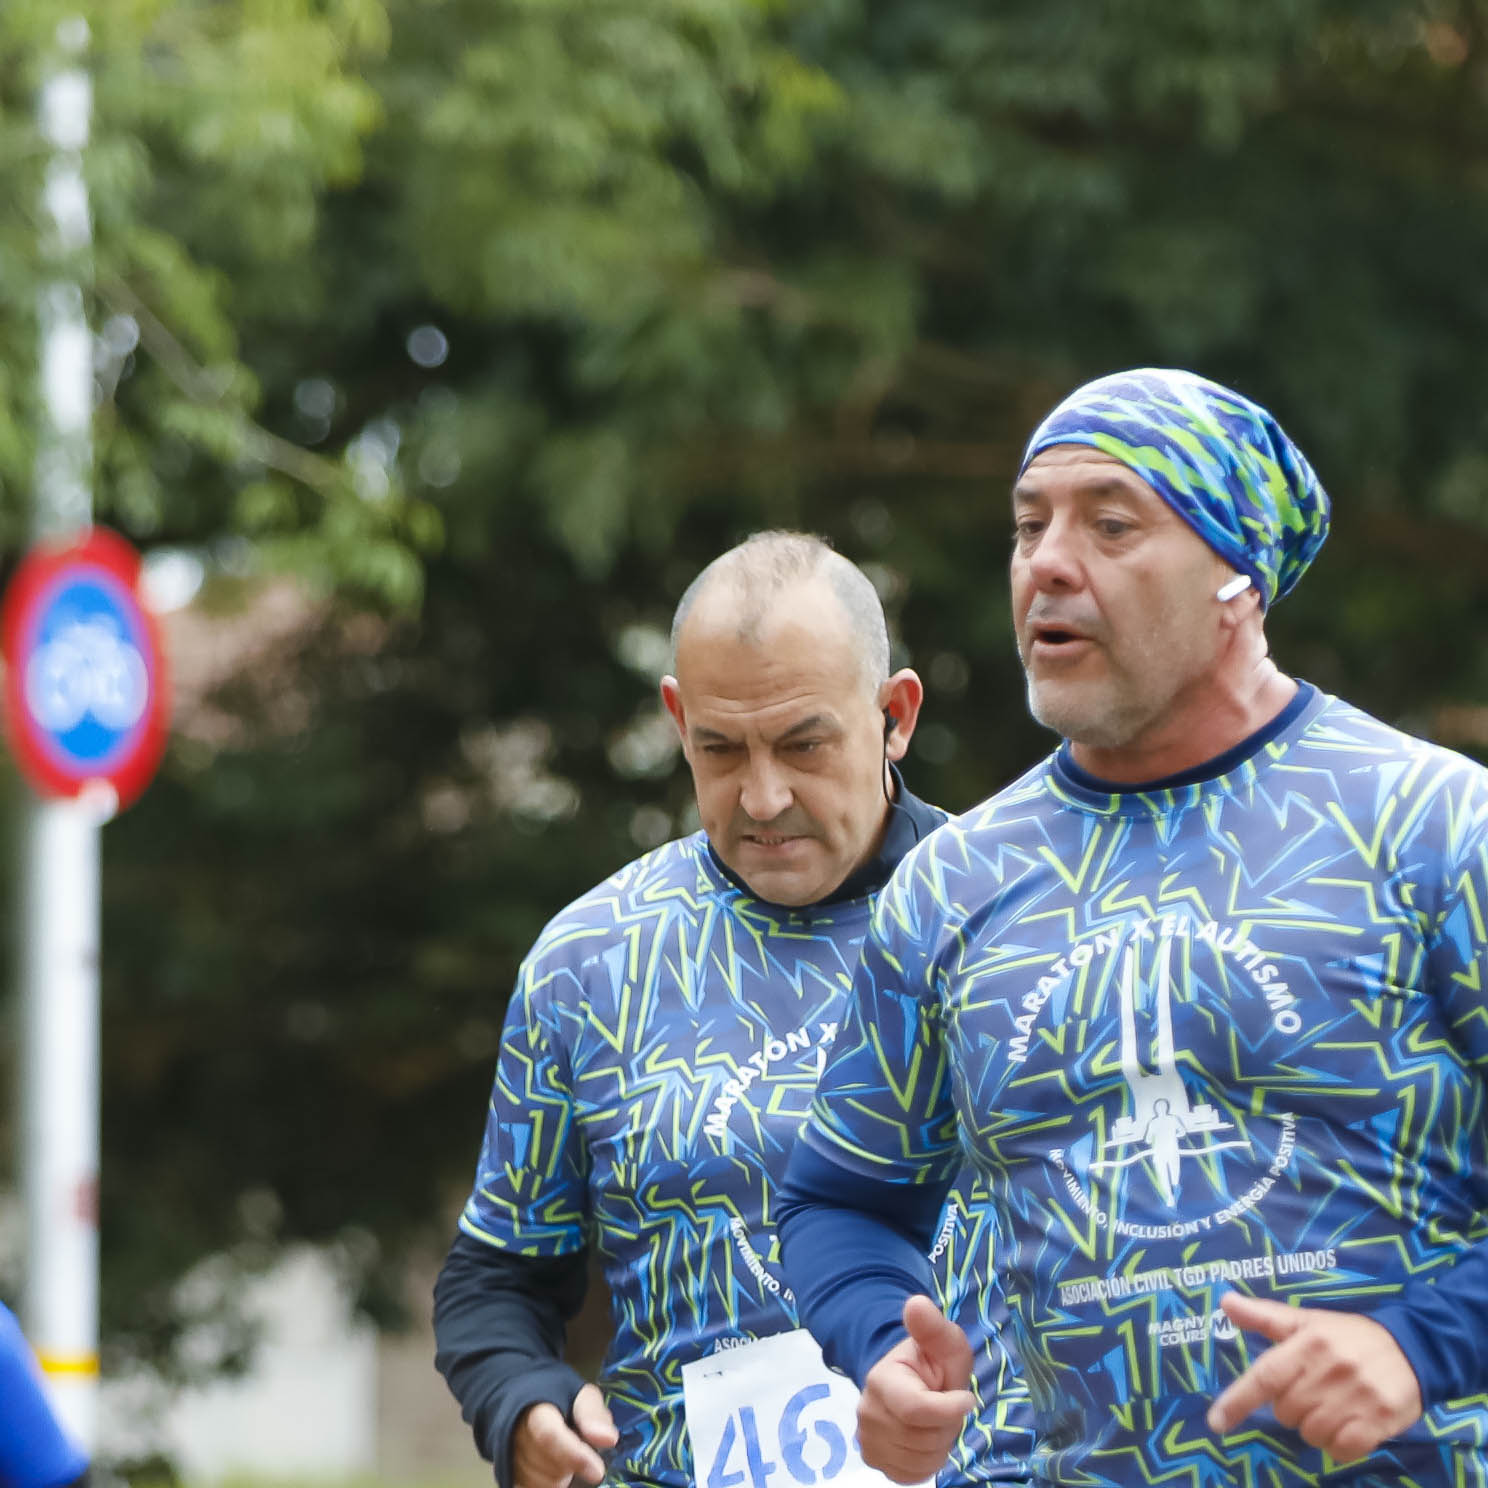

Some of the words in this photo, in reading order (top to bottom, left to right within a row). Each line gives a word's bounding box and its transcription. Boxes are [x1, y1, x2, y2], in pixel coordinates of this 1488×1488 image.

[1130, 917, 1155, 942] X
[1160, 914, 1191, 937] EL
[1195, 920, 1302, 1034] AUTISMO
[818, 1022, 839, 1044] X
[1197, 1215, 1212, 1230] Y
[1269, 1112, 1297, 1177] POSITIVA
[927, 1203, 960, 1264] POSITIVA
[1134, 1271, 1174, 1293] CIVIL
[1175, 1267, 1206, 1288] TGD
[1209, 1258, 1274, 1283] PADRES
[1277, 1249, 1337, 1275] UNIDOS
[1148, 1315, 1206, 1335] MAGNY
